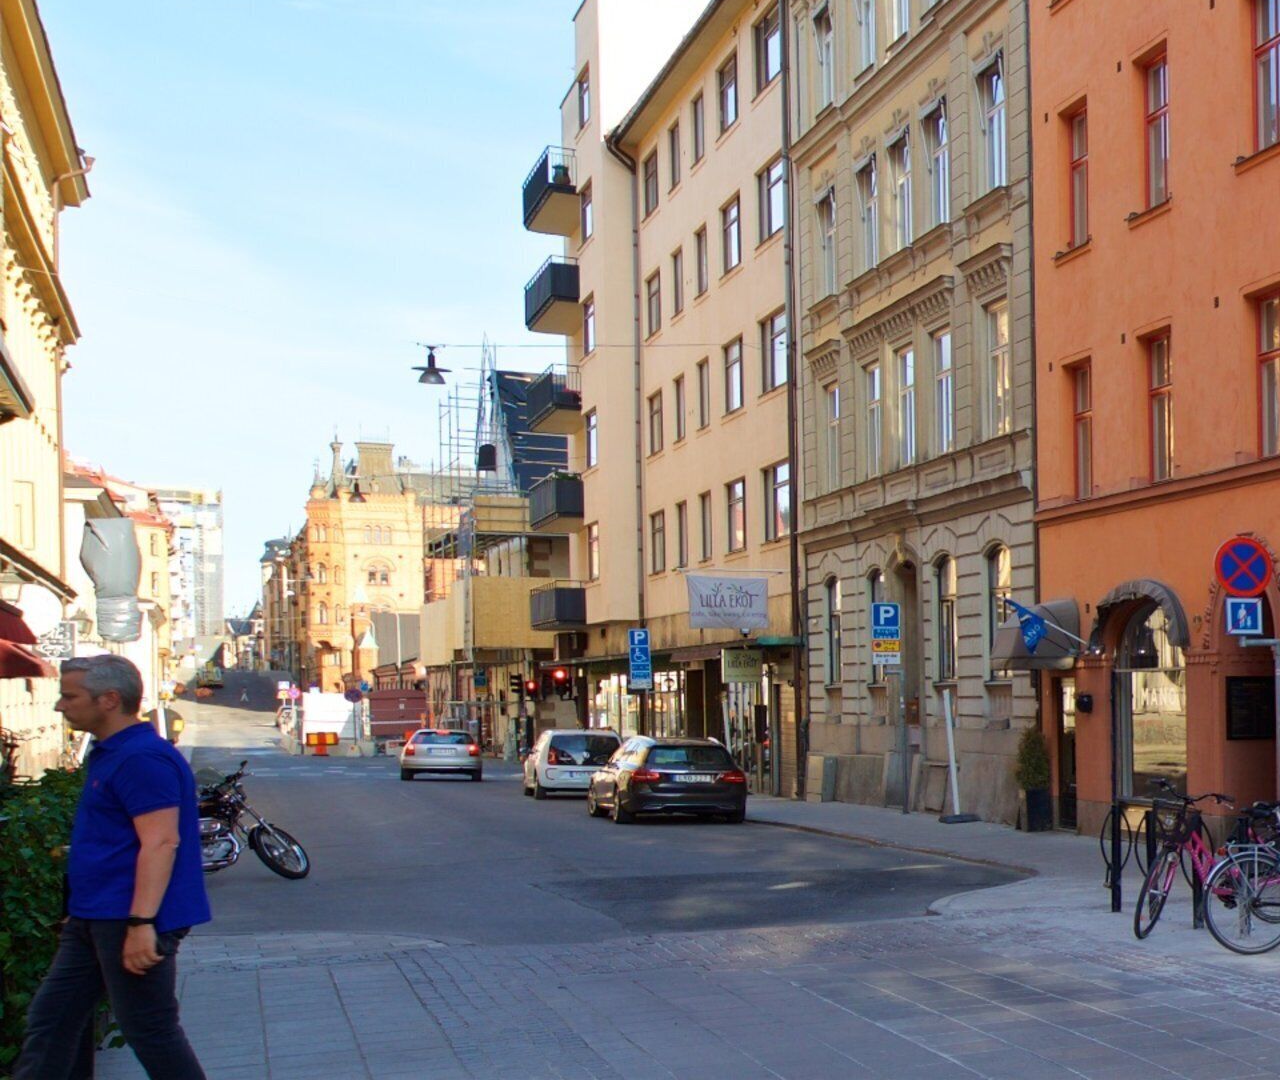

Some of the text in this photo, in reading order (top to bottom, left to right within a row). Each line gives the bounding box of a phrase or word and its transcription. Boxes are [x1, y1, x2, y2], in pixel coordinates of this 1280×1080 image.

[700, 591, 759, 609] LILLA EKOT
[880, 606, 895, 625] P
[634, 631, 646, 645] P
